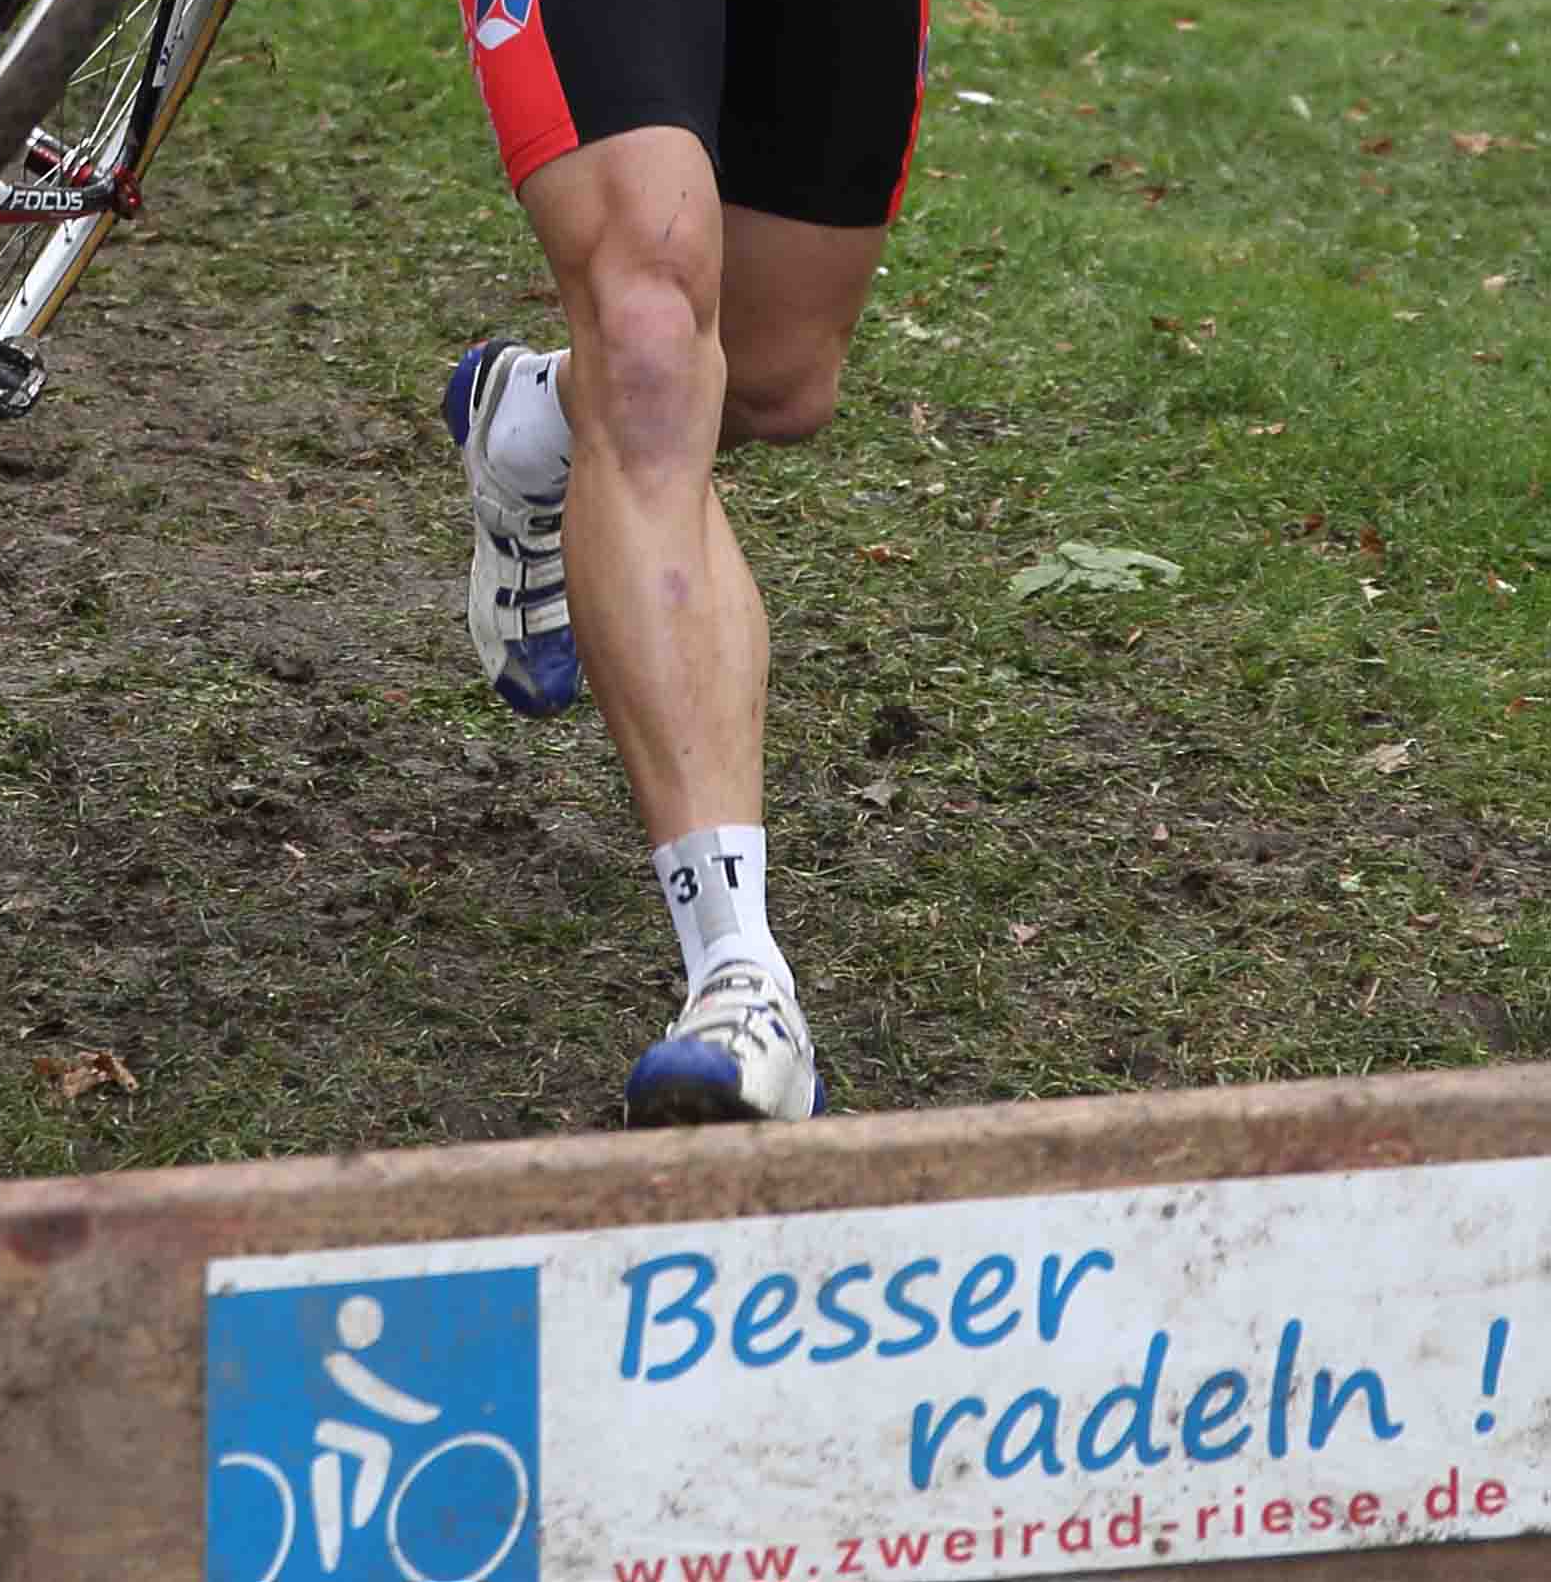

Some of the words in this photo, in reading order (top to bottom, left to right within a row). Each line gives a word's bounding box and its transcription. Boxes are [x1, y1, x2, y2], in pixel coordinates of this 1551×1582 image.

[8, 190, 84, 211] FOCUS
[620, 1249, 1115, 1382] Besser
[907, 1318, 1404, 1492] radeln
[613, 1466, 1509, 1582] www.zweirad-riese.de
